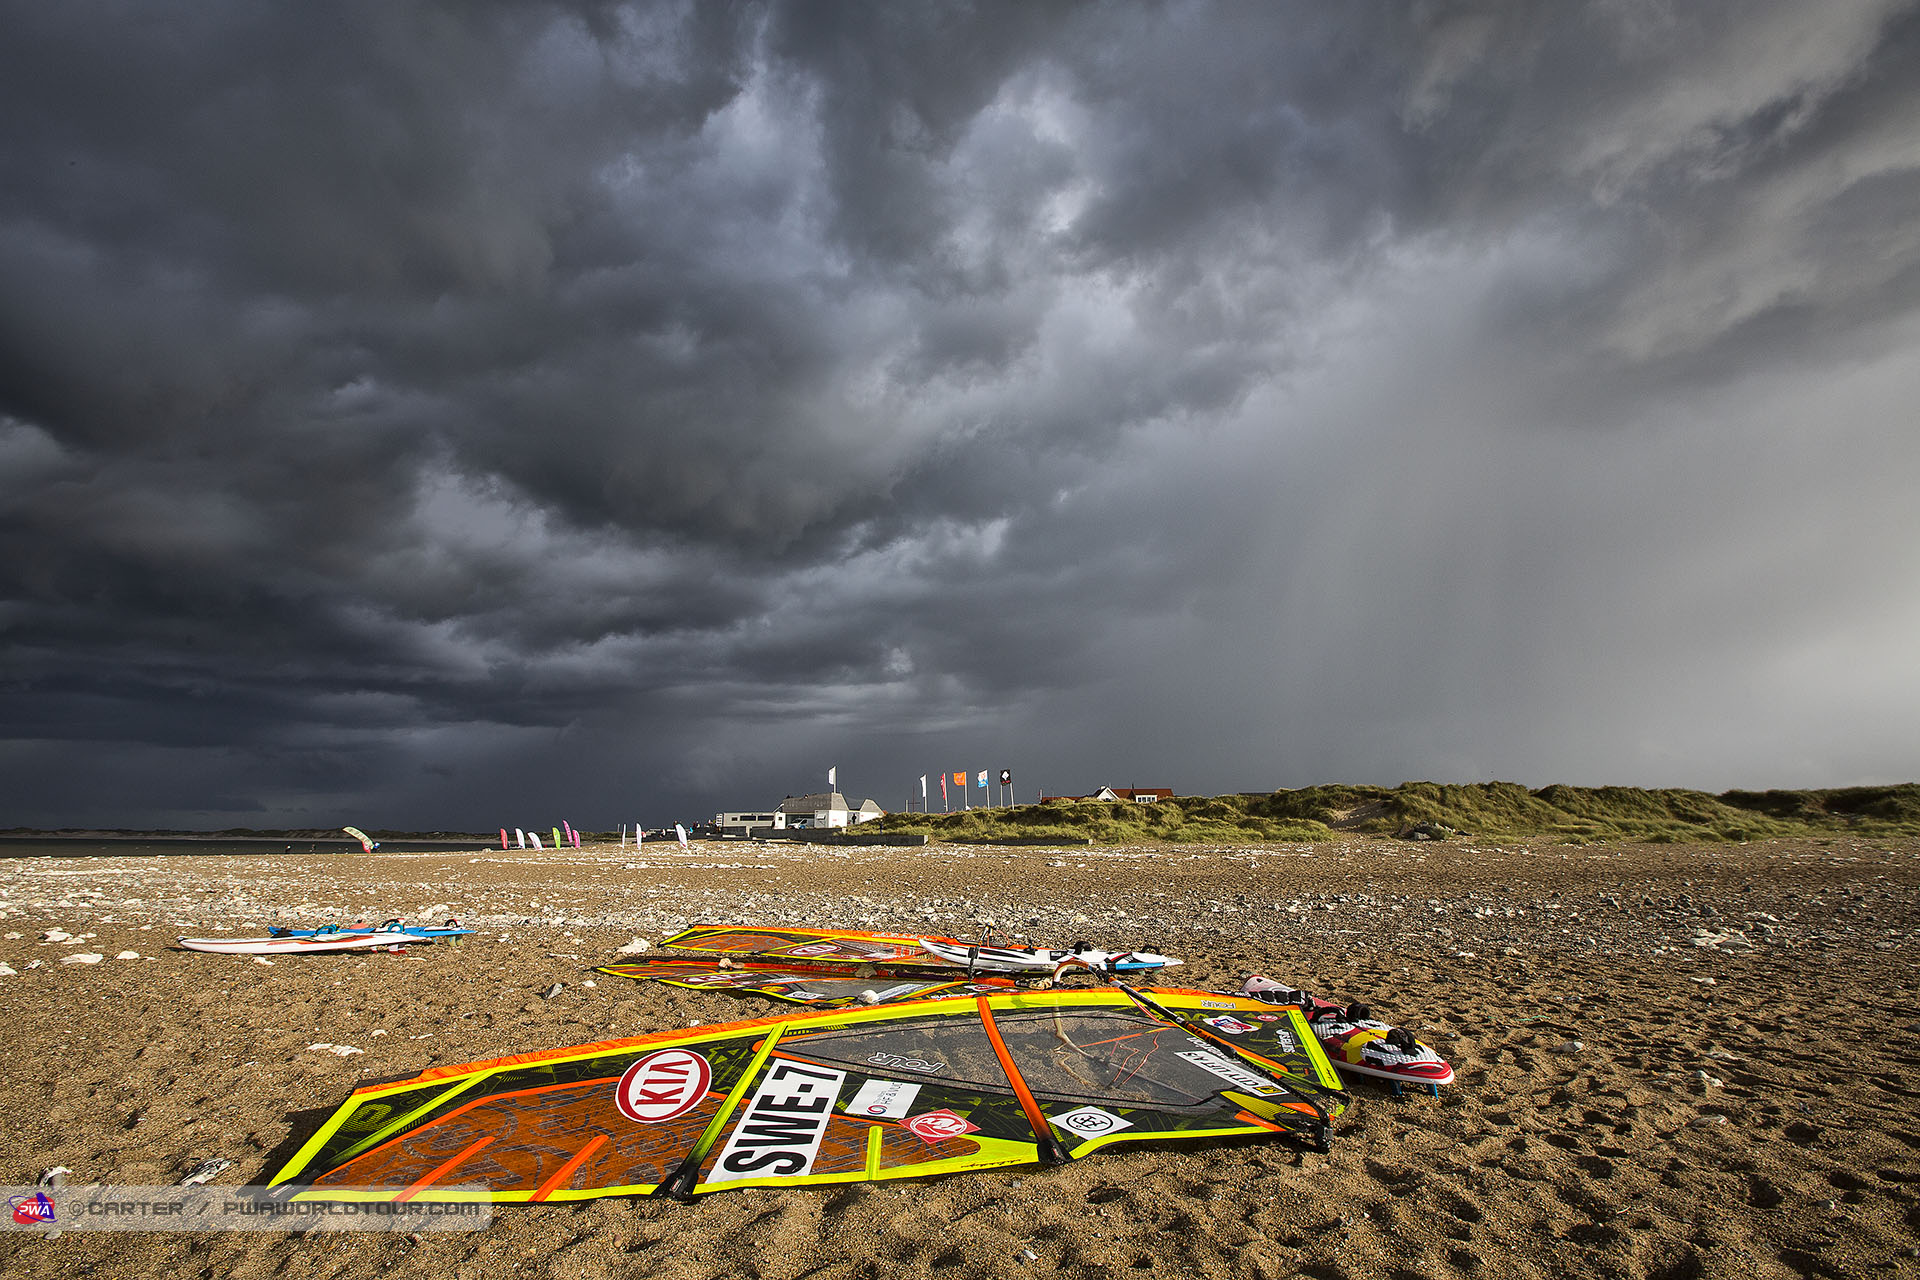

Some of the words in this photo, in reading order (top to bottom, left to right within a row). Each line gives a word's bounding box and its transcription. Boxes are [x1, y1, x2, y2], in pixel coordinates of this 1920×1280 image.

[635, 1060, 693, 1106] KIA
[866, 1052, 946, 1074] FOUR
[723, 1065, 838, 1174] SWE-7
